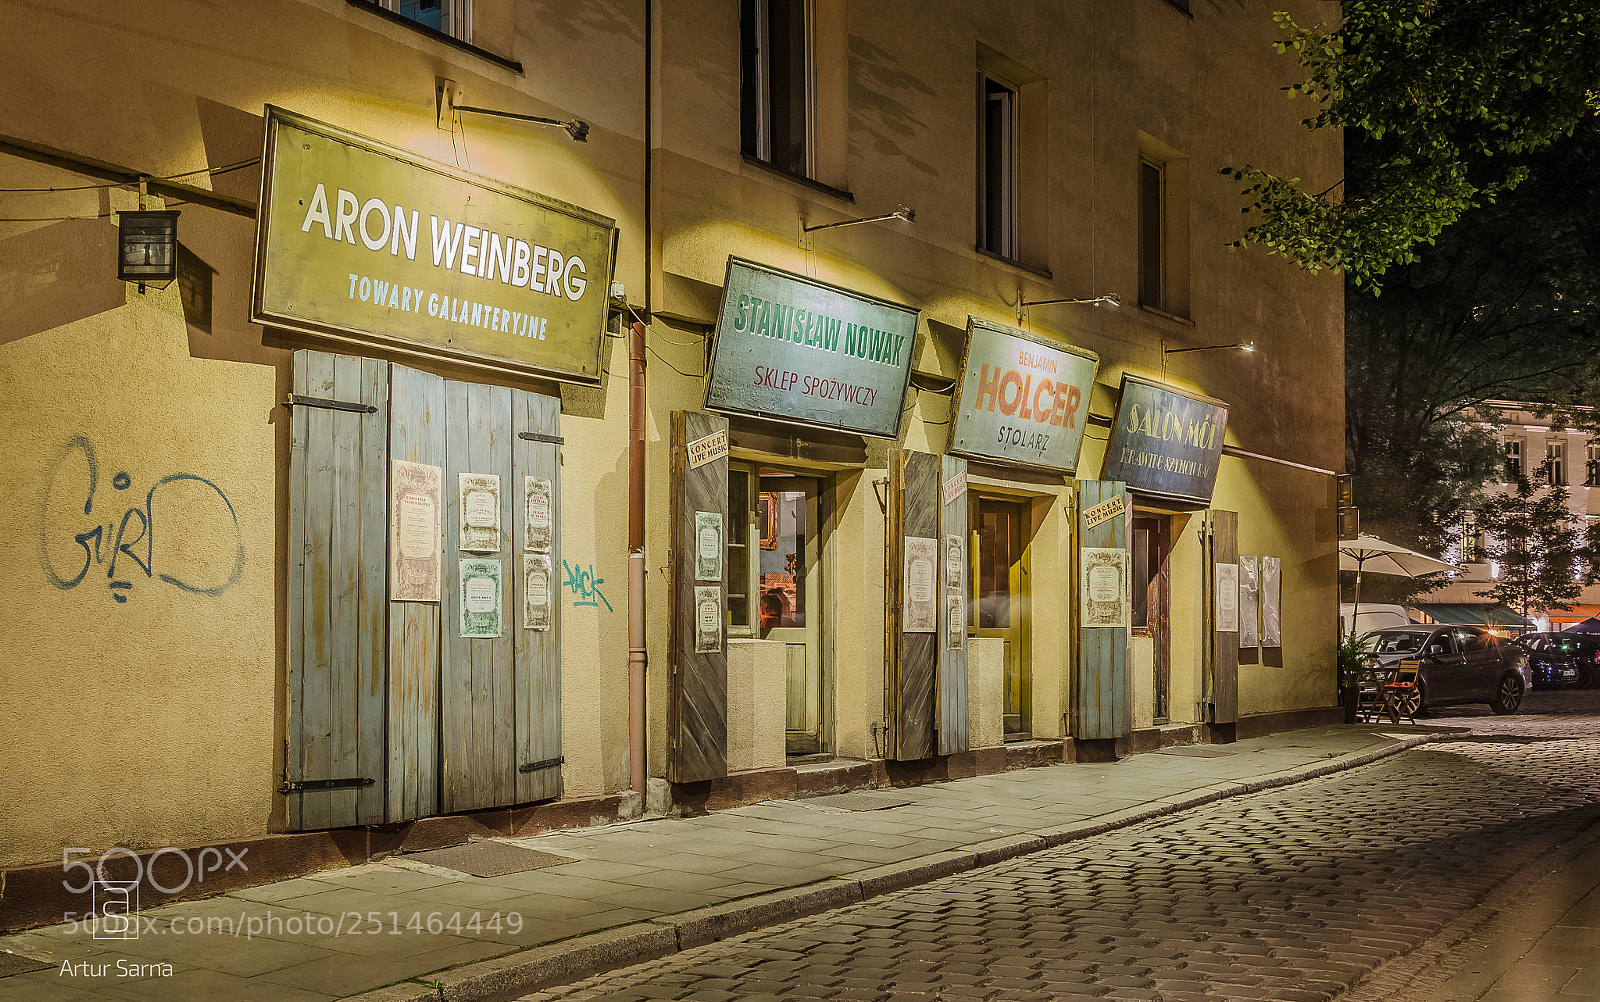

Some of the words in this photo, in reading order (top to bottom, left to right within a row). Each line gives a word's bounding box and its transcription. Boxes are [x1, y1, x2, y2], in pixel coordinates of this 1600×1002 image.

[301, 183, 420, 262] ARON
[430, 214, 588, 302] WEINBERG
[349, 273, 424, 314] TOWARY
[428, 292, 548, 341] GALANTERYJNE
[734, 294, 842, 354] STANISŁAW
[844, 322, 905, 368] NOWAK
[1018, 351, 1058, 375] BENJAMIN
[753, 365, 798, 392] SKLEP
[801, 375, 878, 407] SPOŻYWCZY
[974, 362, 1081, 430] HOLCER
[997, 425, 1050, 451] STOLARZ
[1126, 403, 1184, 443] SALON
[1184, 414, 1219, 451] MÓD
[707, 443, 728, 458] MUSIC
[1084, 498, 1121, 520] KONCERT
[1087, 514, 1102, 526] LIVE
[1103, 504, 1123, 519] MUSIC
